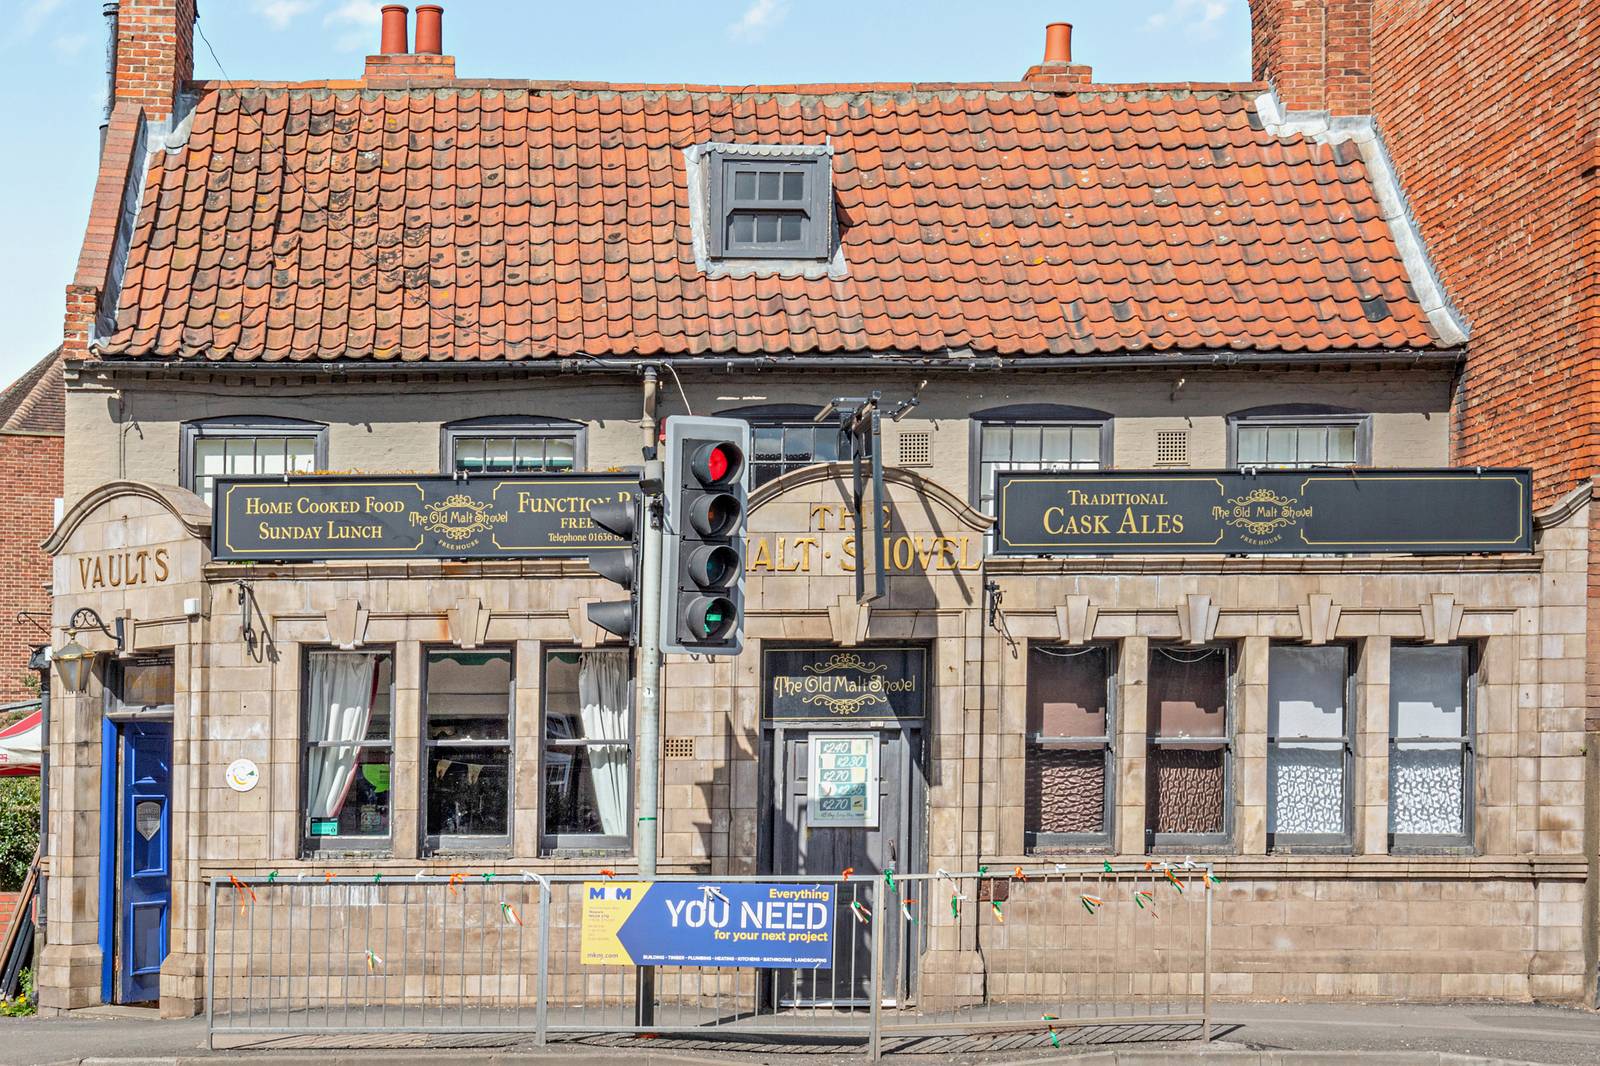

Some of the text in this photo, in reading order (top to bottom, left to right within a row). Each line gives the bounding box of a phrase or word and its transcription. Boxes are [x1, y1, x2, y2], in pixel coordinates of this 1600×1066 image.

[245, 496, 405, 515] HOME COOKED FOOD
[517, 491, 610, 513] FUNCTIO
[1067, 489, 1168, 505] TRADITIONAL
[409, 510, 508, 527] The Old Malt Shovel
[812, 505, 891, 531] TH
[1043, 506, 1184, 534] CASK ALES
[1212, 505, 1313, 520] The Old Malt Shovel
[259, 520, 383, 540] SUNDAY LUNCH
[548, 532, 587, 543] Telephone
[588, 532, 613, 541] 01636
[745, 535, 983, 571] ALT SOVEL
[78, 548, 170, 589] VAULTS
[774, 674, 916, 698] The Old Malt Shovel
[769, 888, 829, 901] Everything
[665, 898, 828, 930] YOU NEED
[714, 929, 828, 943] for your next project
